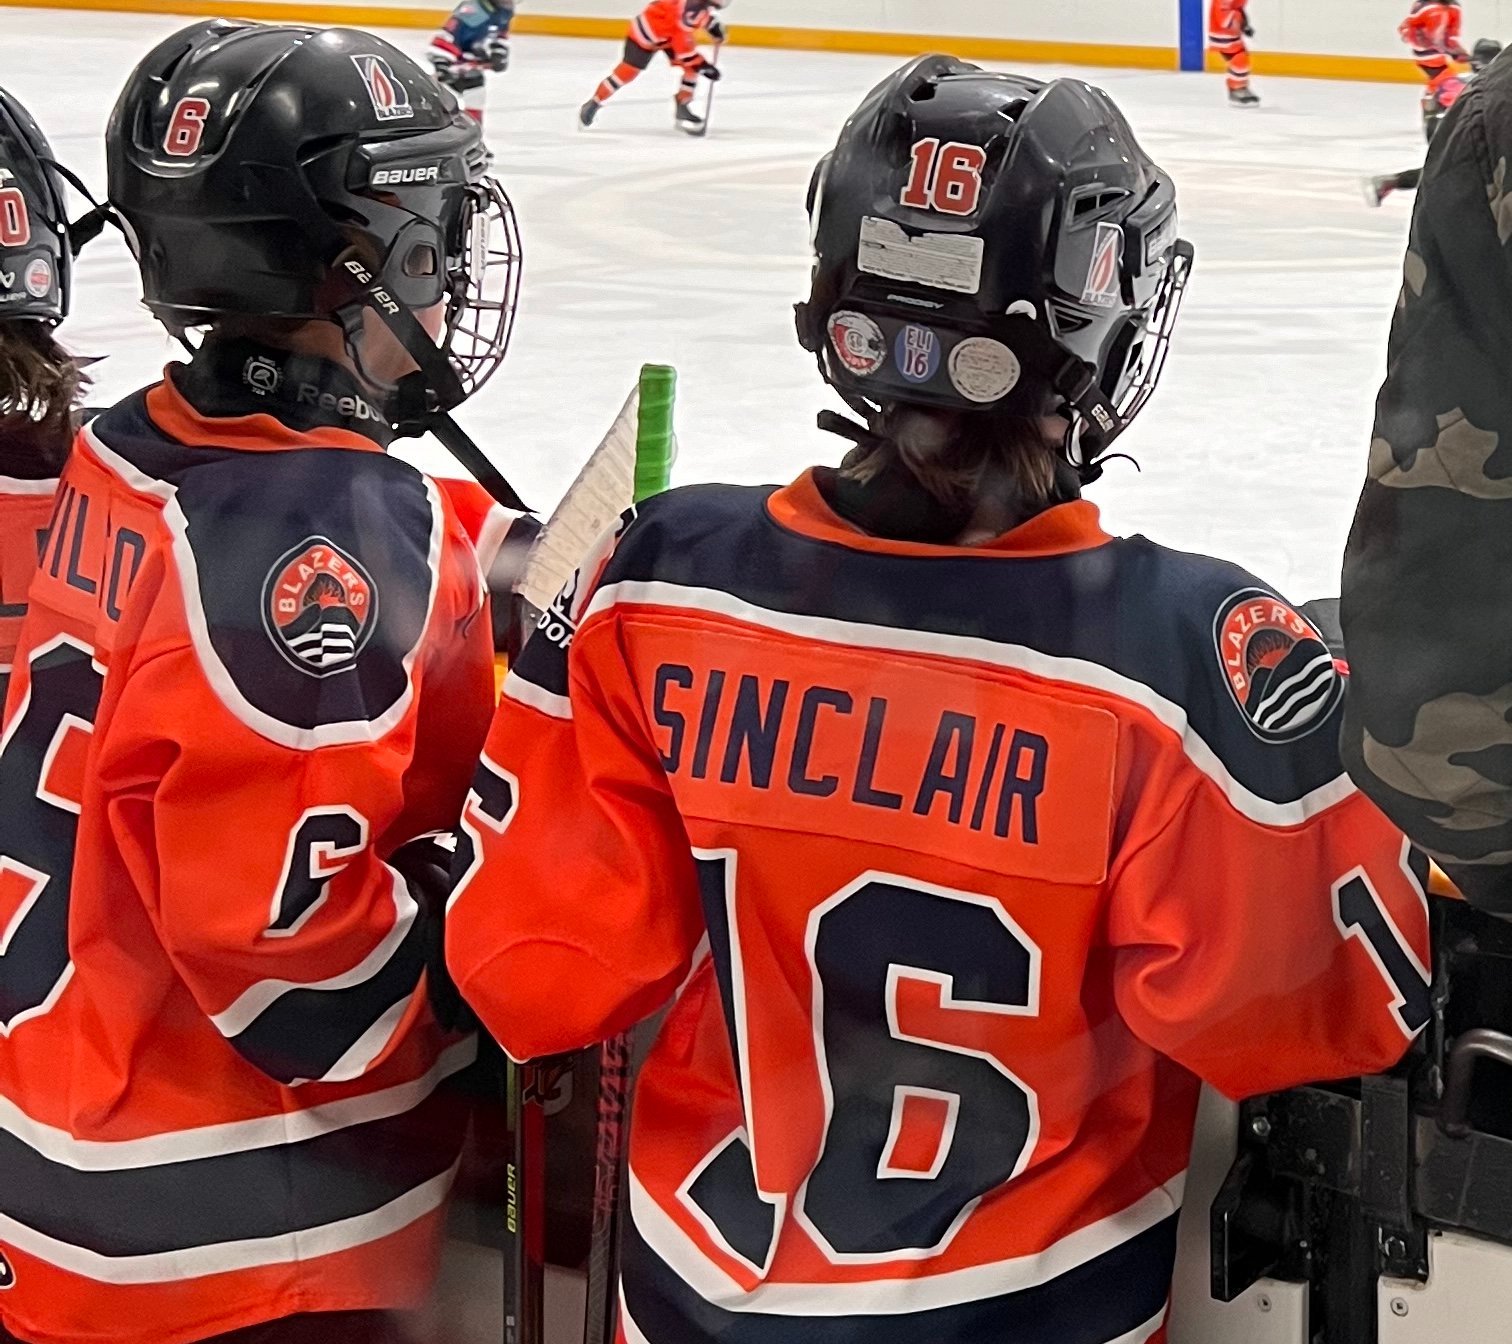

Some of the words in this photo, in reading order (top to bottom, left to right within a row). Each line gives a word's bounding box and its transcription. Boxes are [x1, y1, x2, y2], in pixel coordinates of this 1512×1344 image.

[162, 97, 212, 157] 6
[373, 166, 438, 185] BAUER
[899, 137, 988, 216] 16
[903, 348, 930, 378] 16
[905, 325, 934, 353] ELI
[278, 551, 365, 613] BLAZERS
[1229, 604, 1306, 690] BLAZERS
[653, 662, 1050, 846] SINCLAIR
[677, 846, 1042, 1292] 16
[507, 1163, 517, 1233] BAUER
